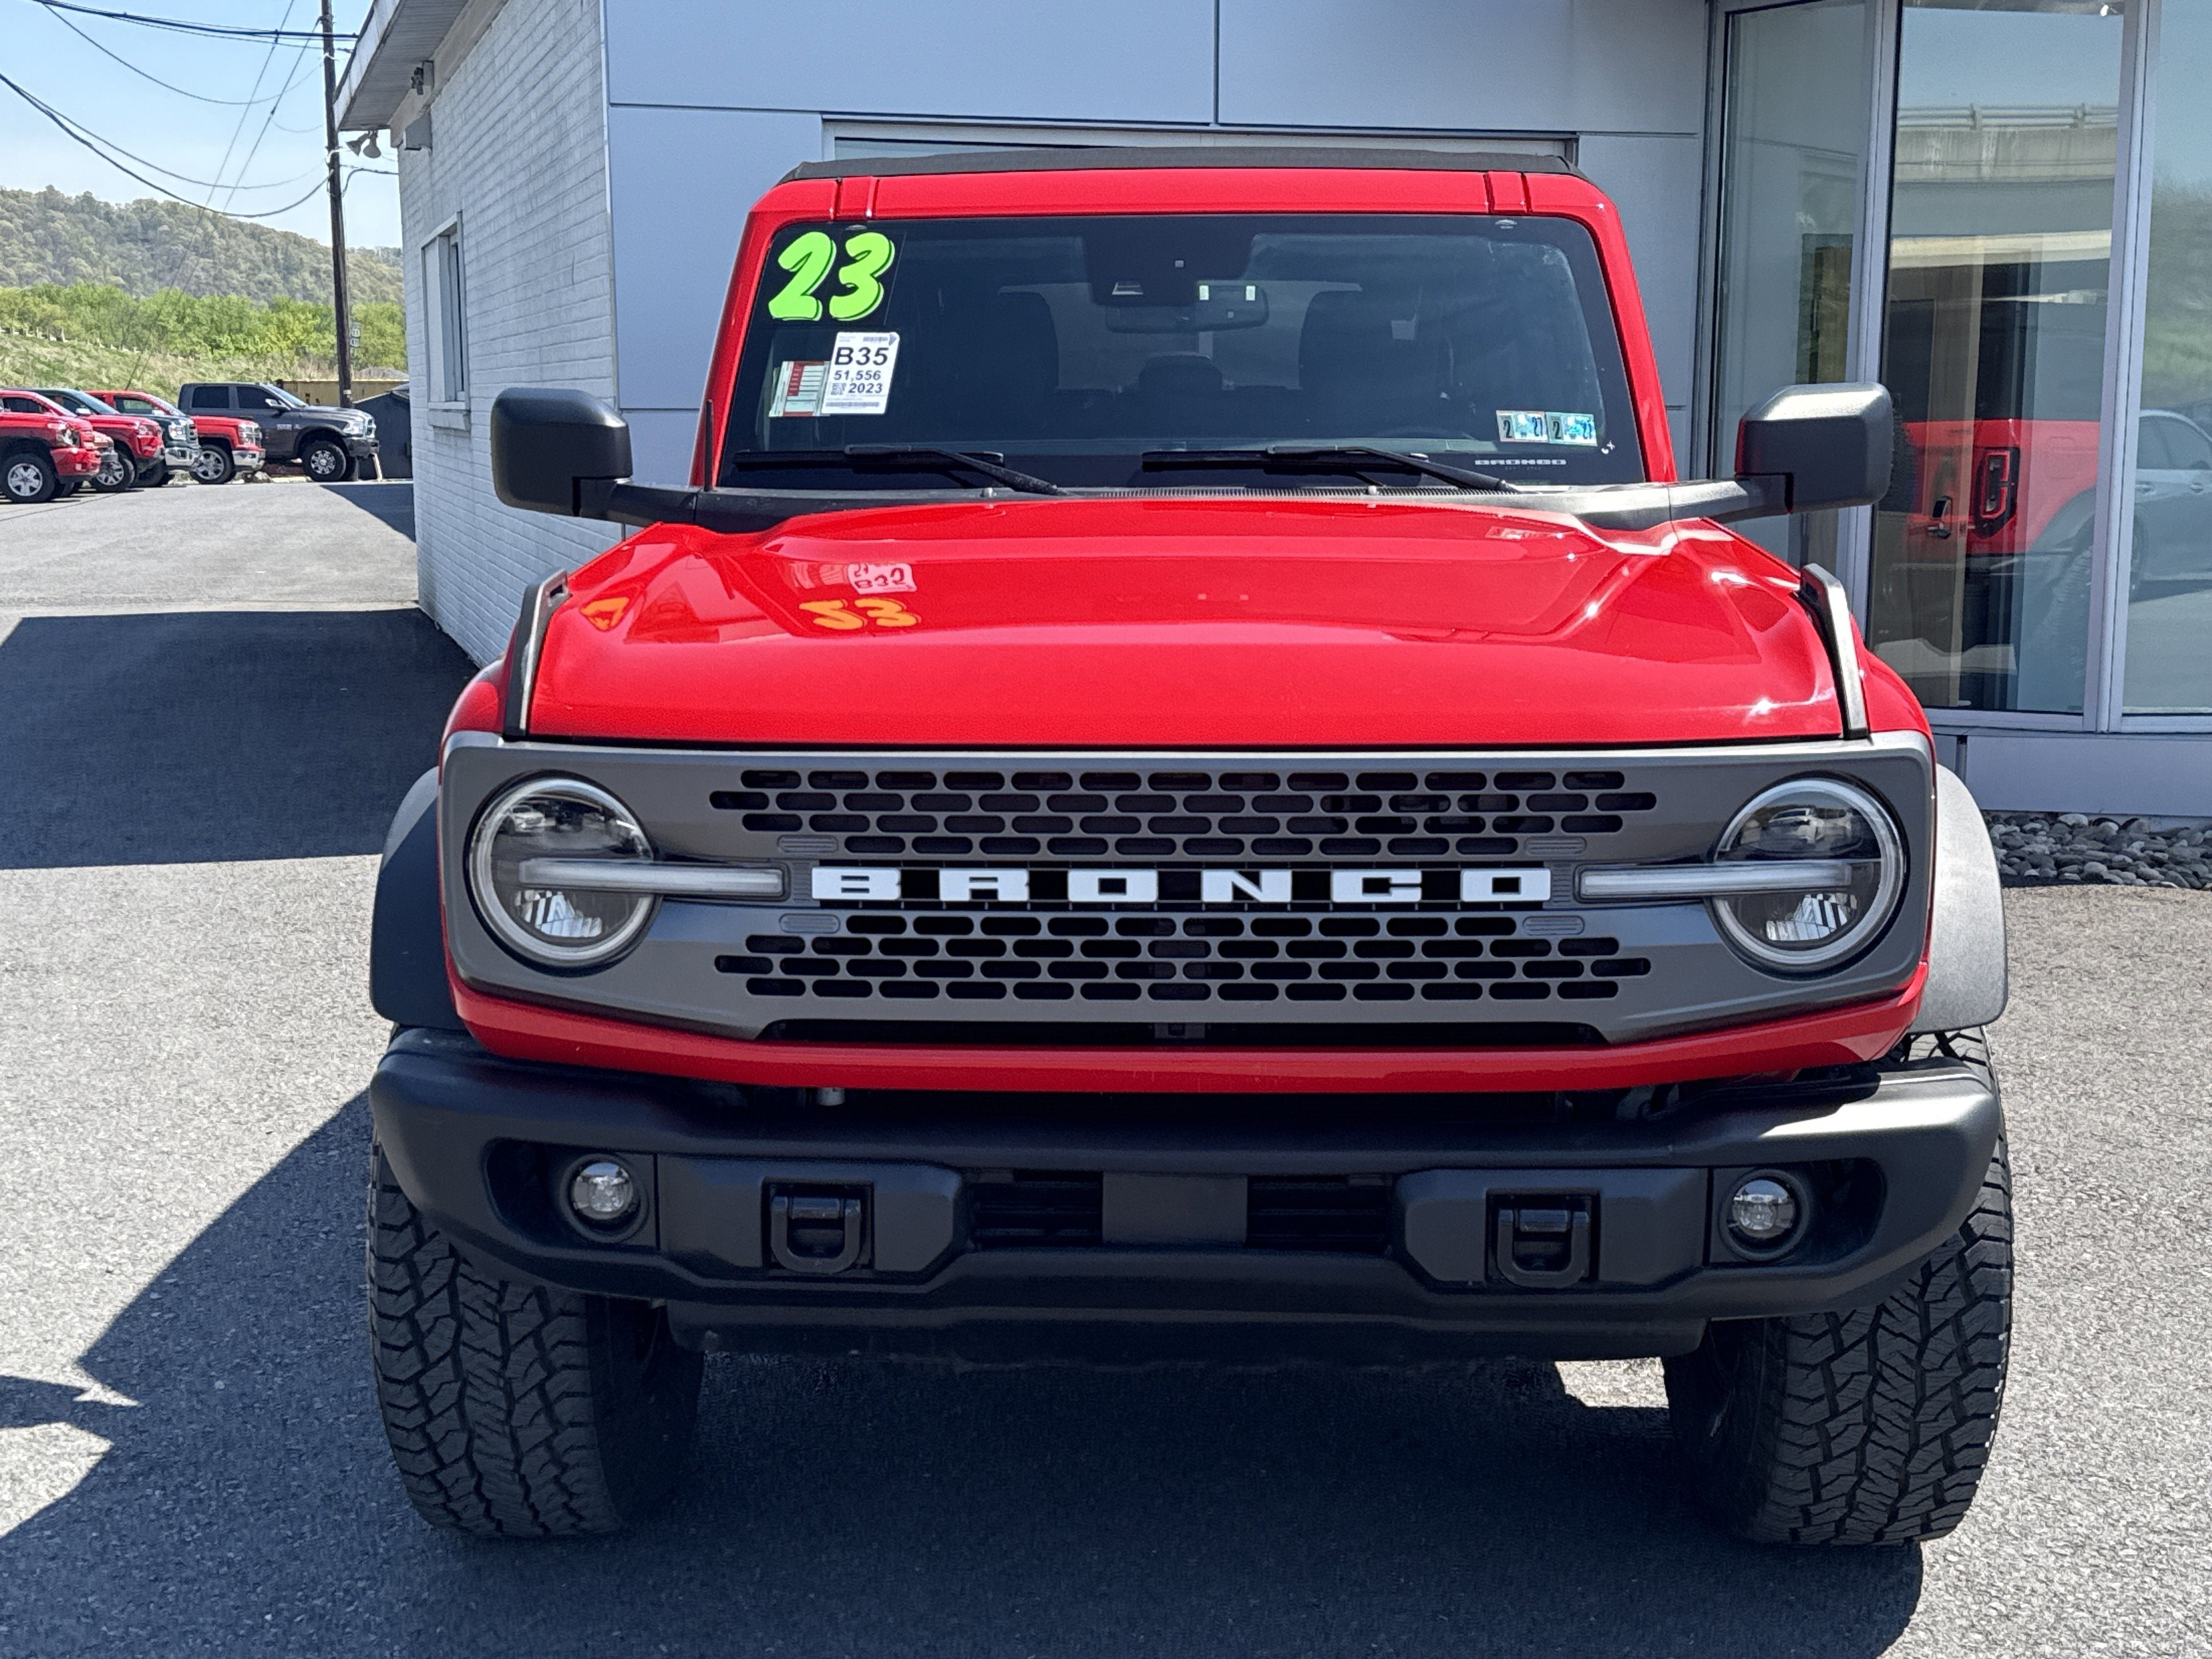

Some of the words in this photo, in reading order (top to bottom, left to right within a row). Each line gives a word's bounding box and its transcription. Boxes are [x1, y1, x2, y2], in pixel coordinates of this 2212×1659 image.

[769, 232, 895, 321] 23
[834, 346, 889, 366] B35
[833, 369, 882, 382] 51,556
[848, 382, 883, 394] 2023
[812, 866, 1551, 902] BRONCO
